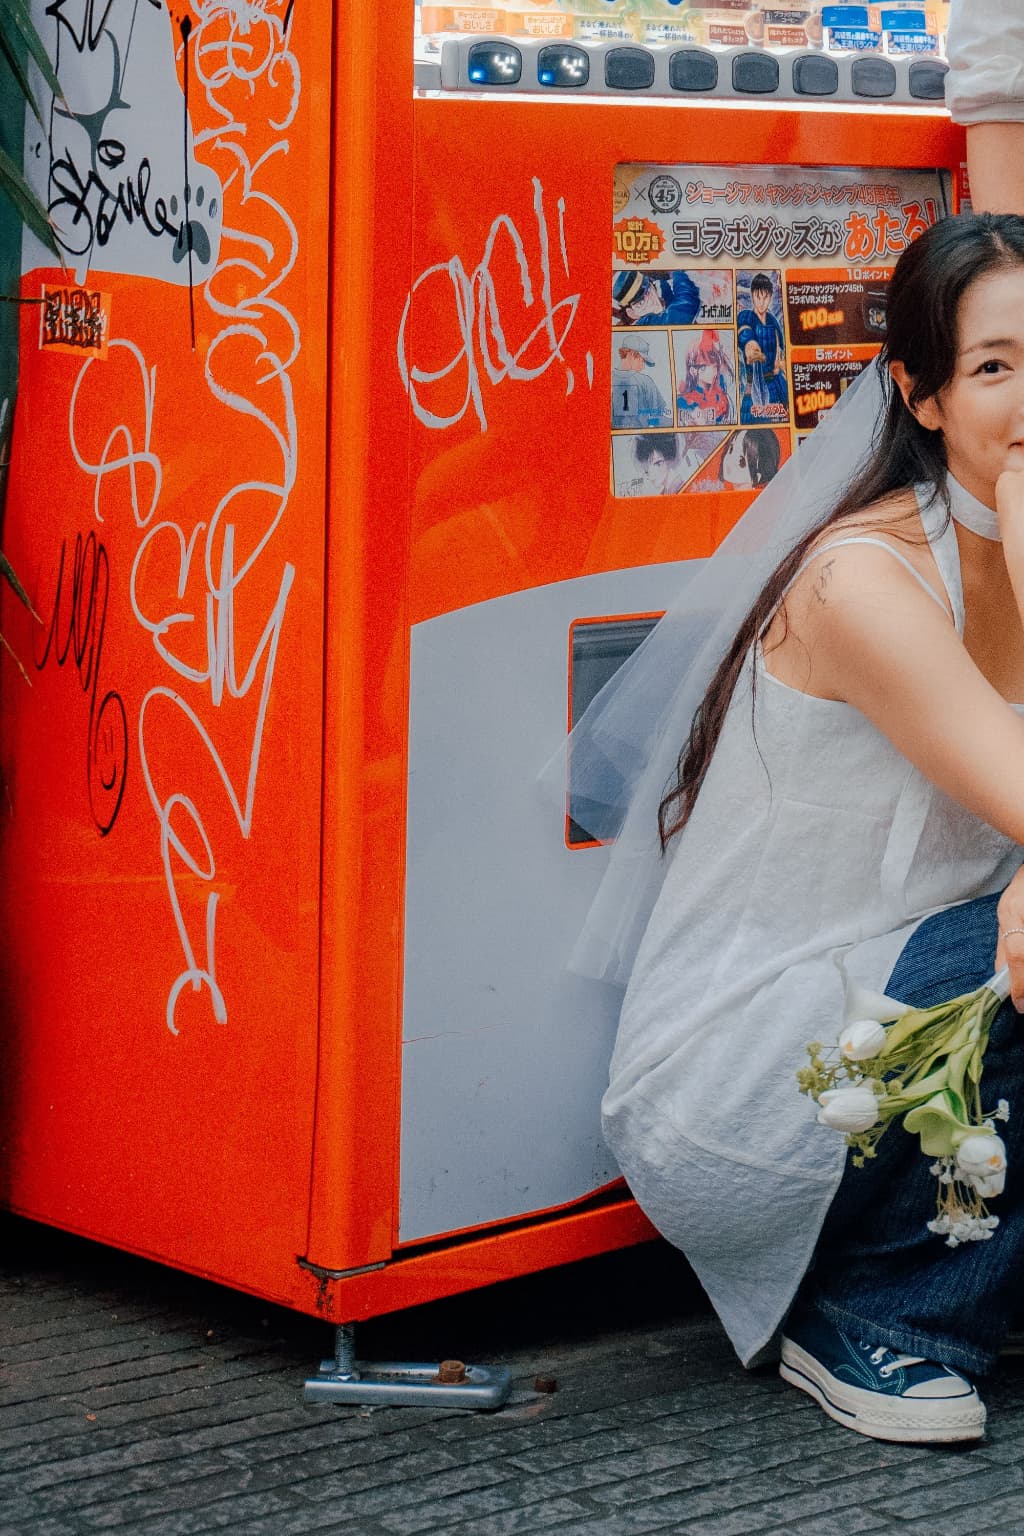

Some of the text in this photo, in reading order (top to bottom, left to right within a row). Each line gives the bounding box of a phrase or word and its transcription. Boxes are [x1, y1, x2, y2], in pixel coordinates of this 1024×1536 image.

[655, 189, 676, 203] 45
[795, 382, 832, 391] コーヒーボトル
[622, 389, 629, 411] 1
